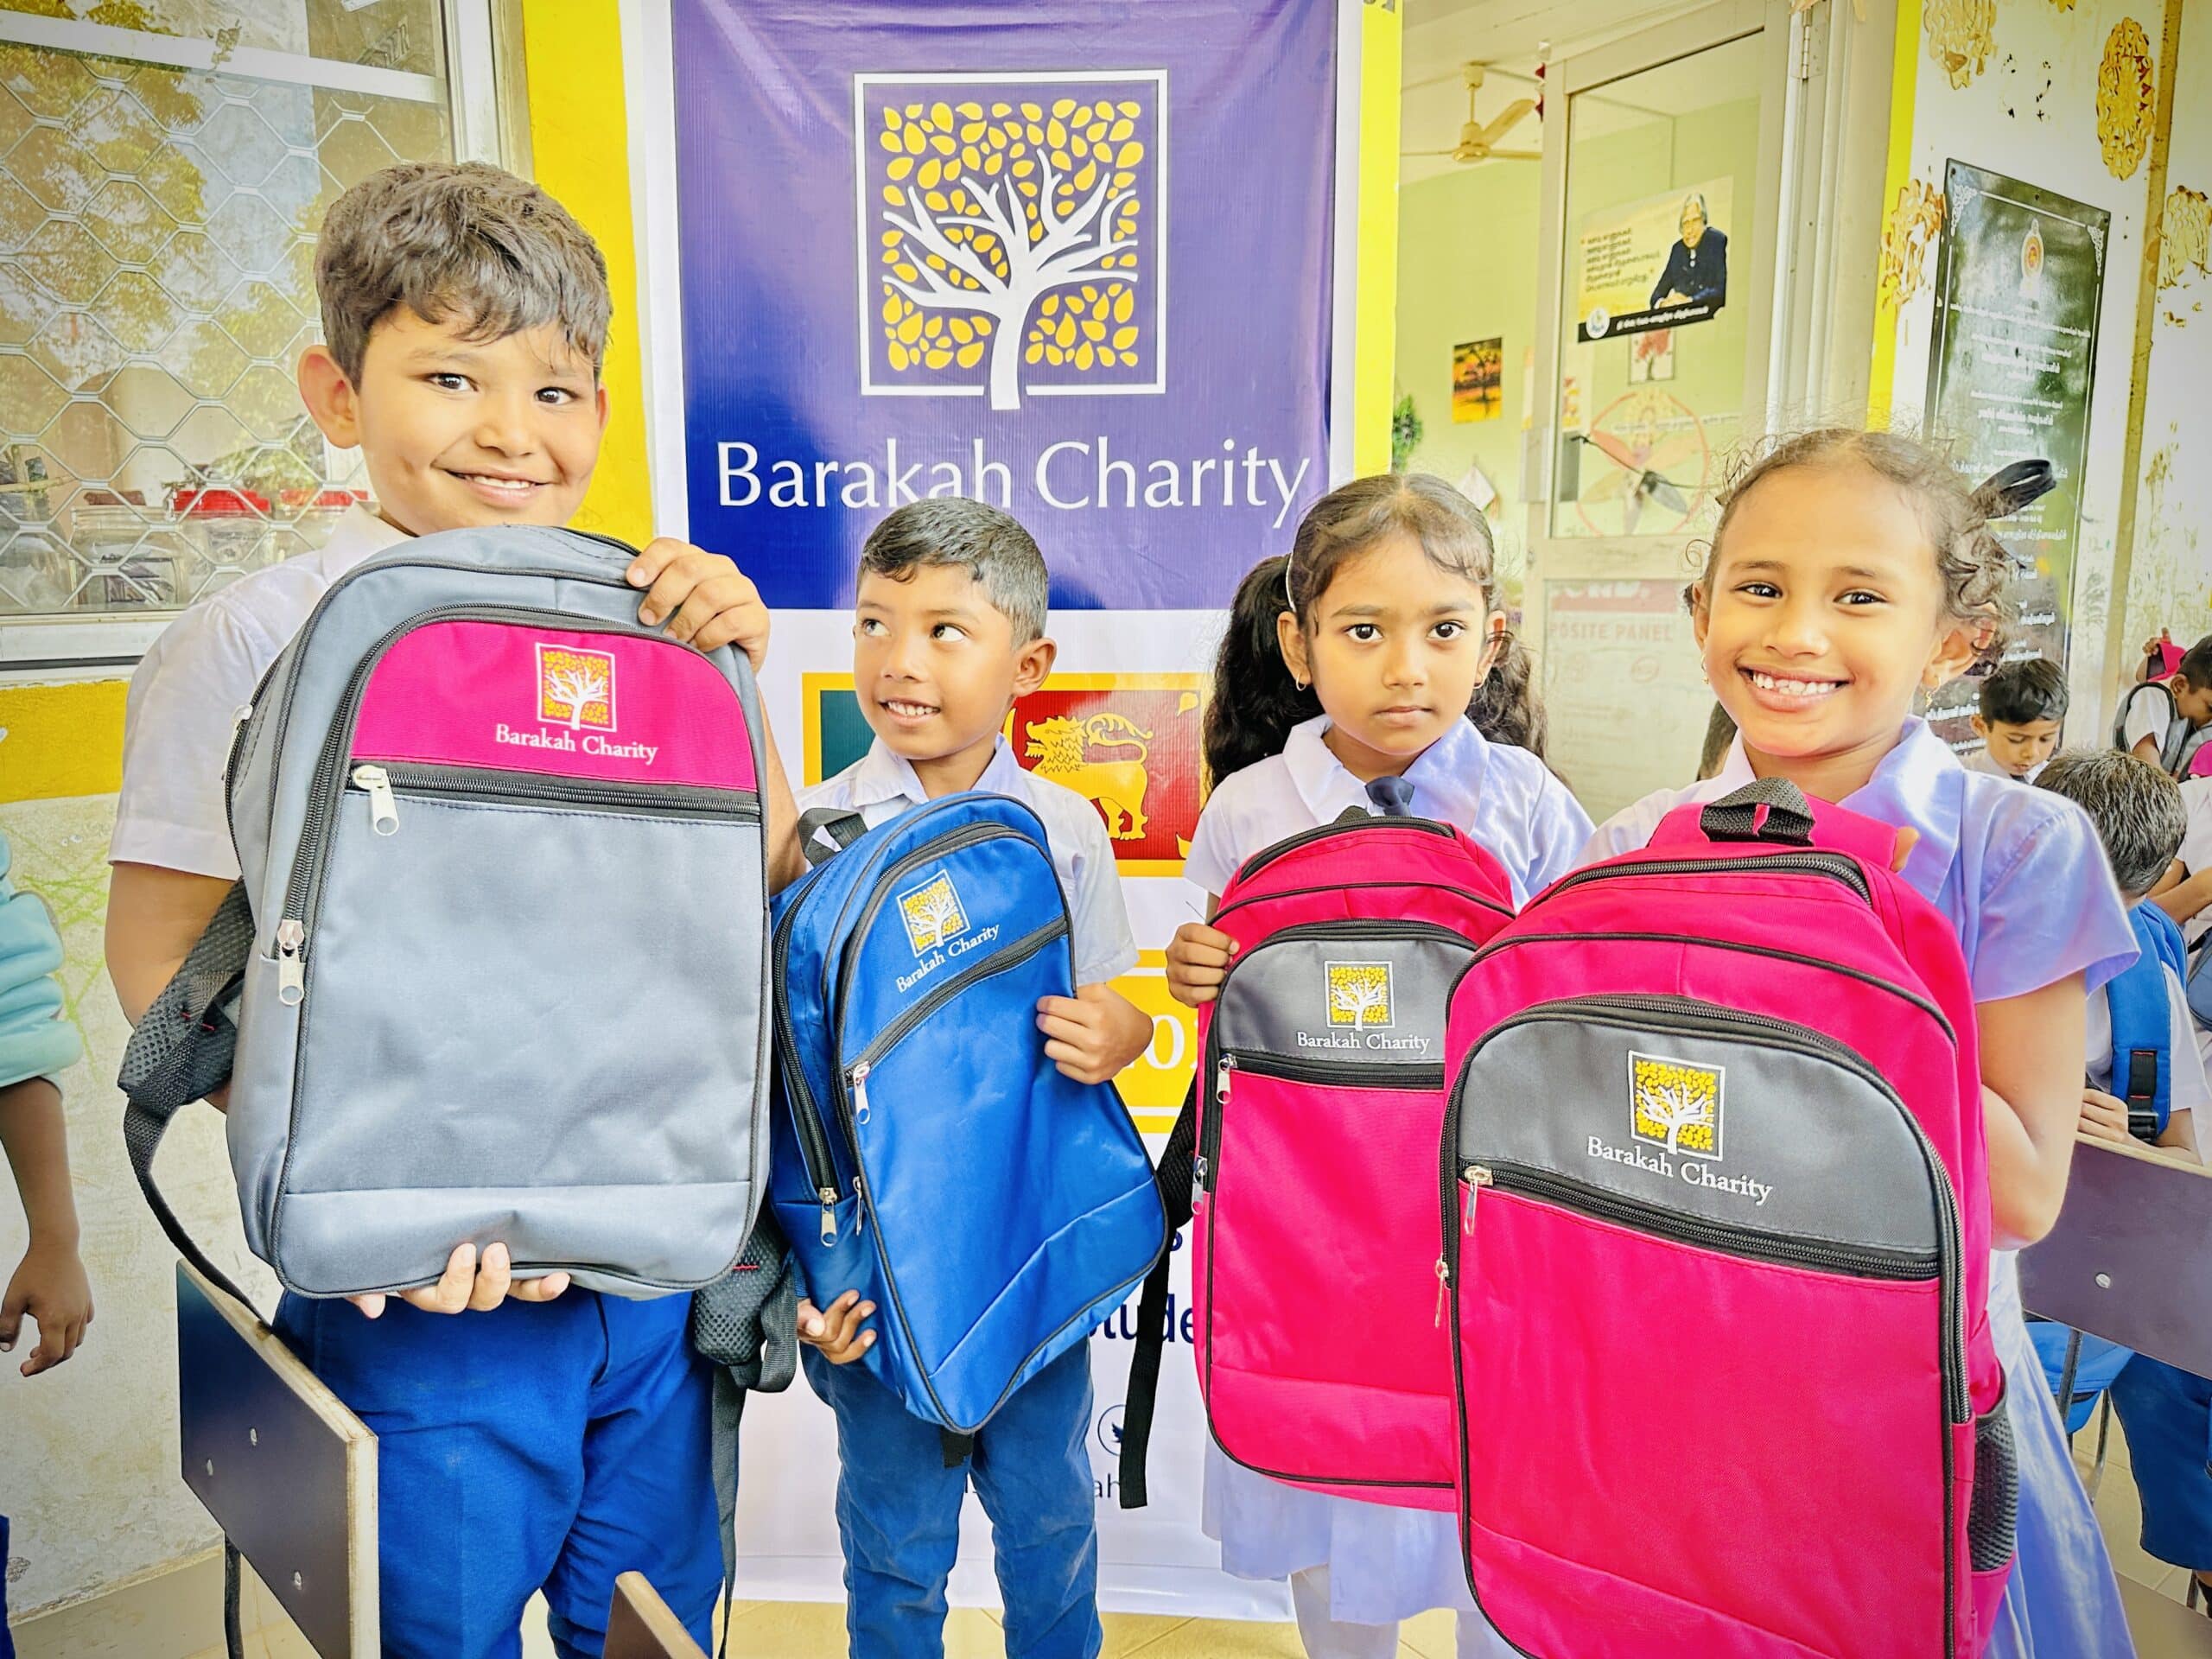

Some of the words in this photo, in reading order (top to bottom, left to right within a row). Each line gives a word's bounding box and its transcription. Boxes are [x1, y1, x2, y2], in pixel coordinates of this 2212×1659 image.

[717, 438, 1012, 508] Barakah
[1036, 435, 1311, 529] Charity
[1615, 622, 1673, 642] PANEL
[495, 723, 576, 753] Barakah
[582, 735, 658, 766] Charity
[895, 950, 946, 994] Barakah
[948, 924, 1000, 957] Charity
[1295, 1031, 1362, 1049] Barakah
[1366, 1033, 1431, 1055] Charity
[1587, 1135, 1674, 1178] Barakah
[1680, 1161, 1773, 1206] Charity
